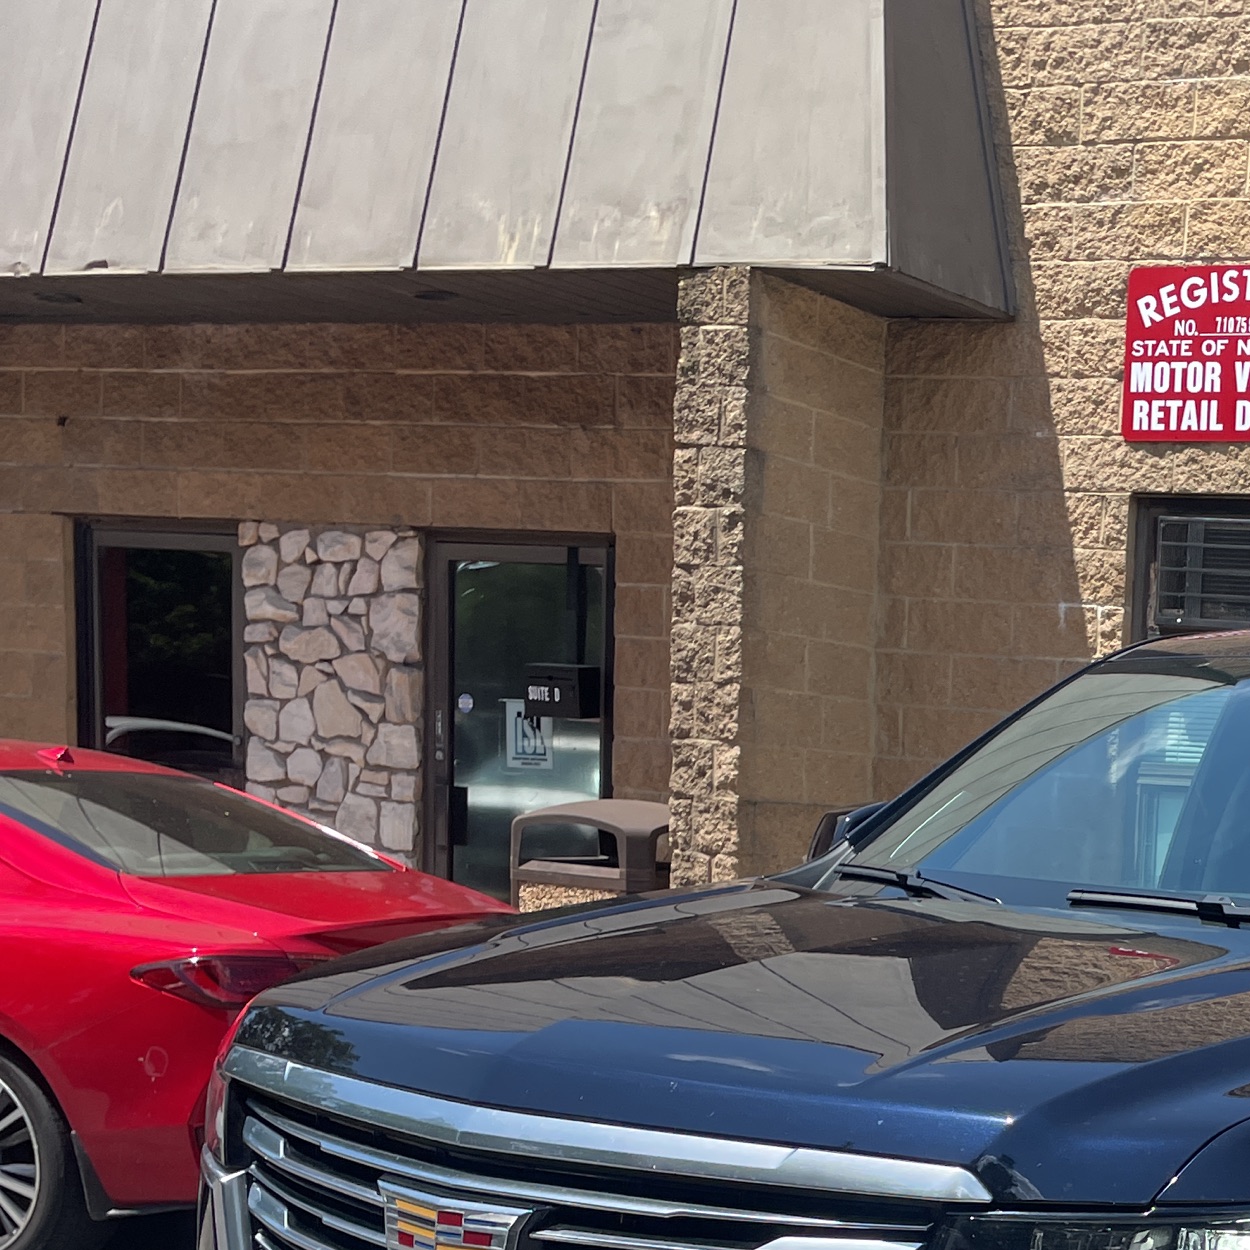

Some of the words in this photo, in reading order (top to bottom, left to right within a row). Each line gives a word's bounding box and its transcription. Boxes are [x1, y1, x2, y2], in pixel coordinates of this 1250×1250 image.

[1174, 319, 1199, 336] NO.
[1131, 340, 1193, 356] STATE
[1201, 340, 1229, 356] OF
[1129, 361, 1222, 393] MOTOR
[1132, 400, 1224, 431] RETAIL
[528, 685, 550, 702] SUITE
[553, 687, 561, 702] D
